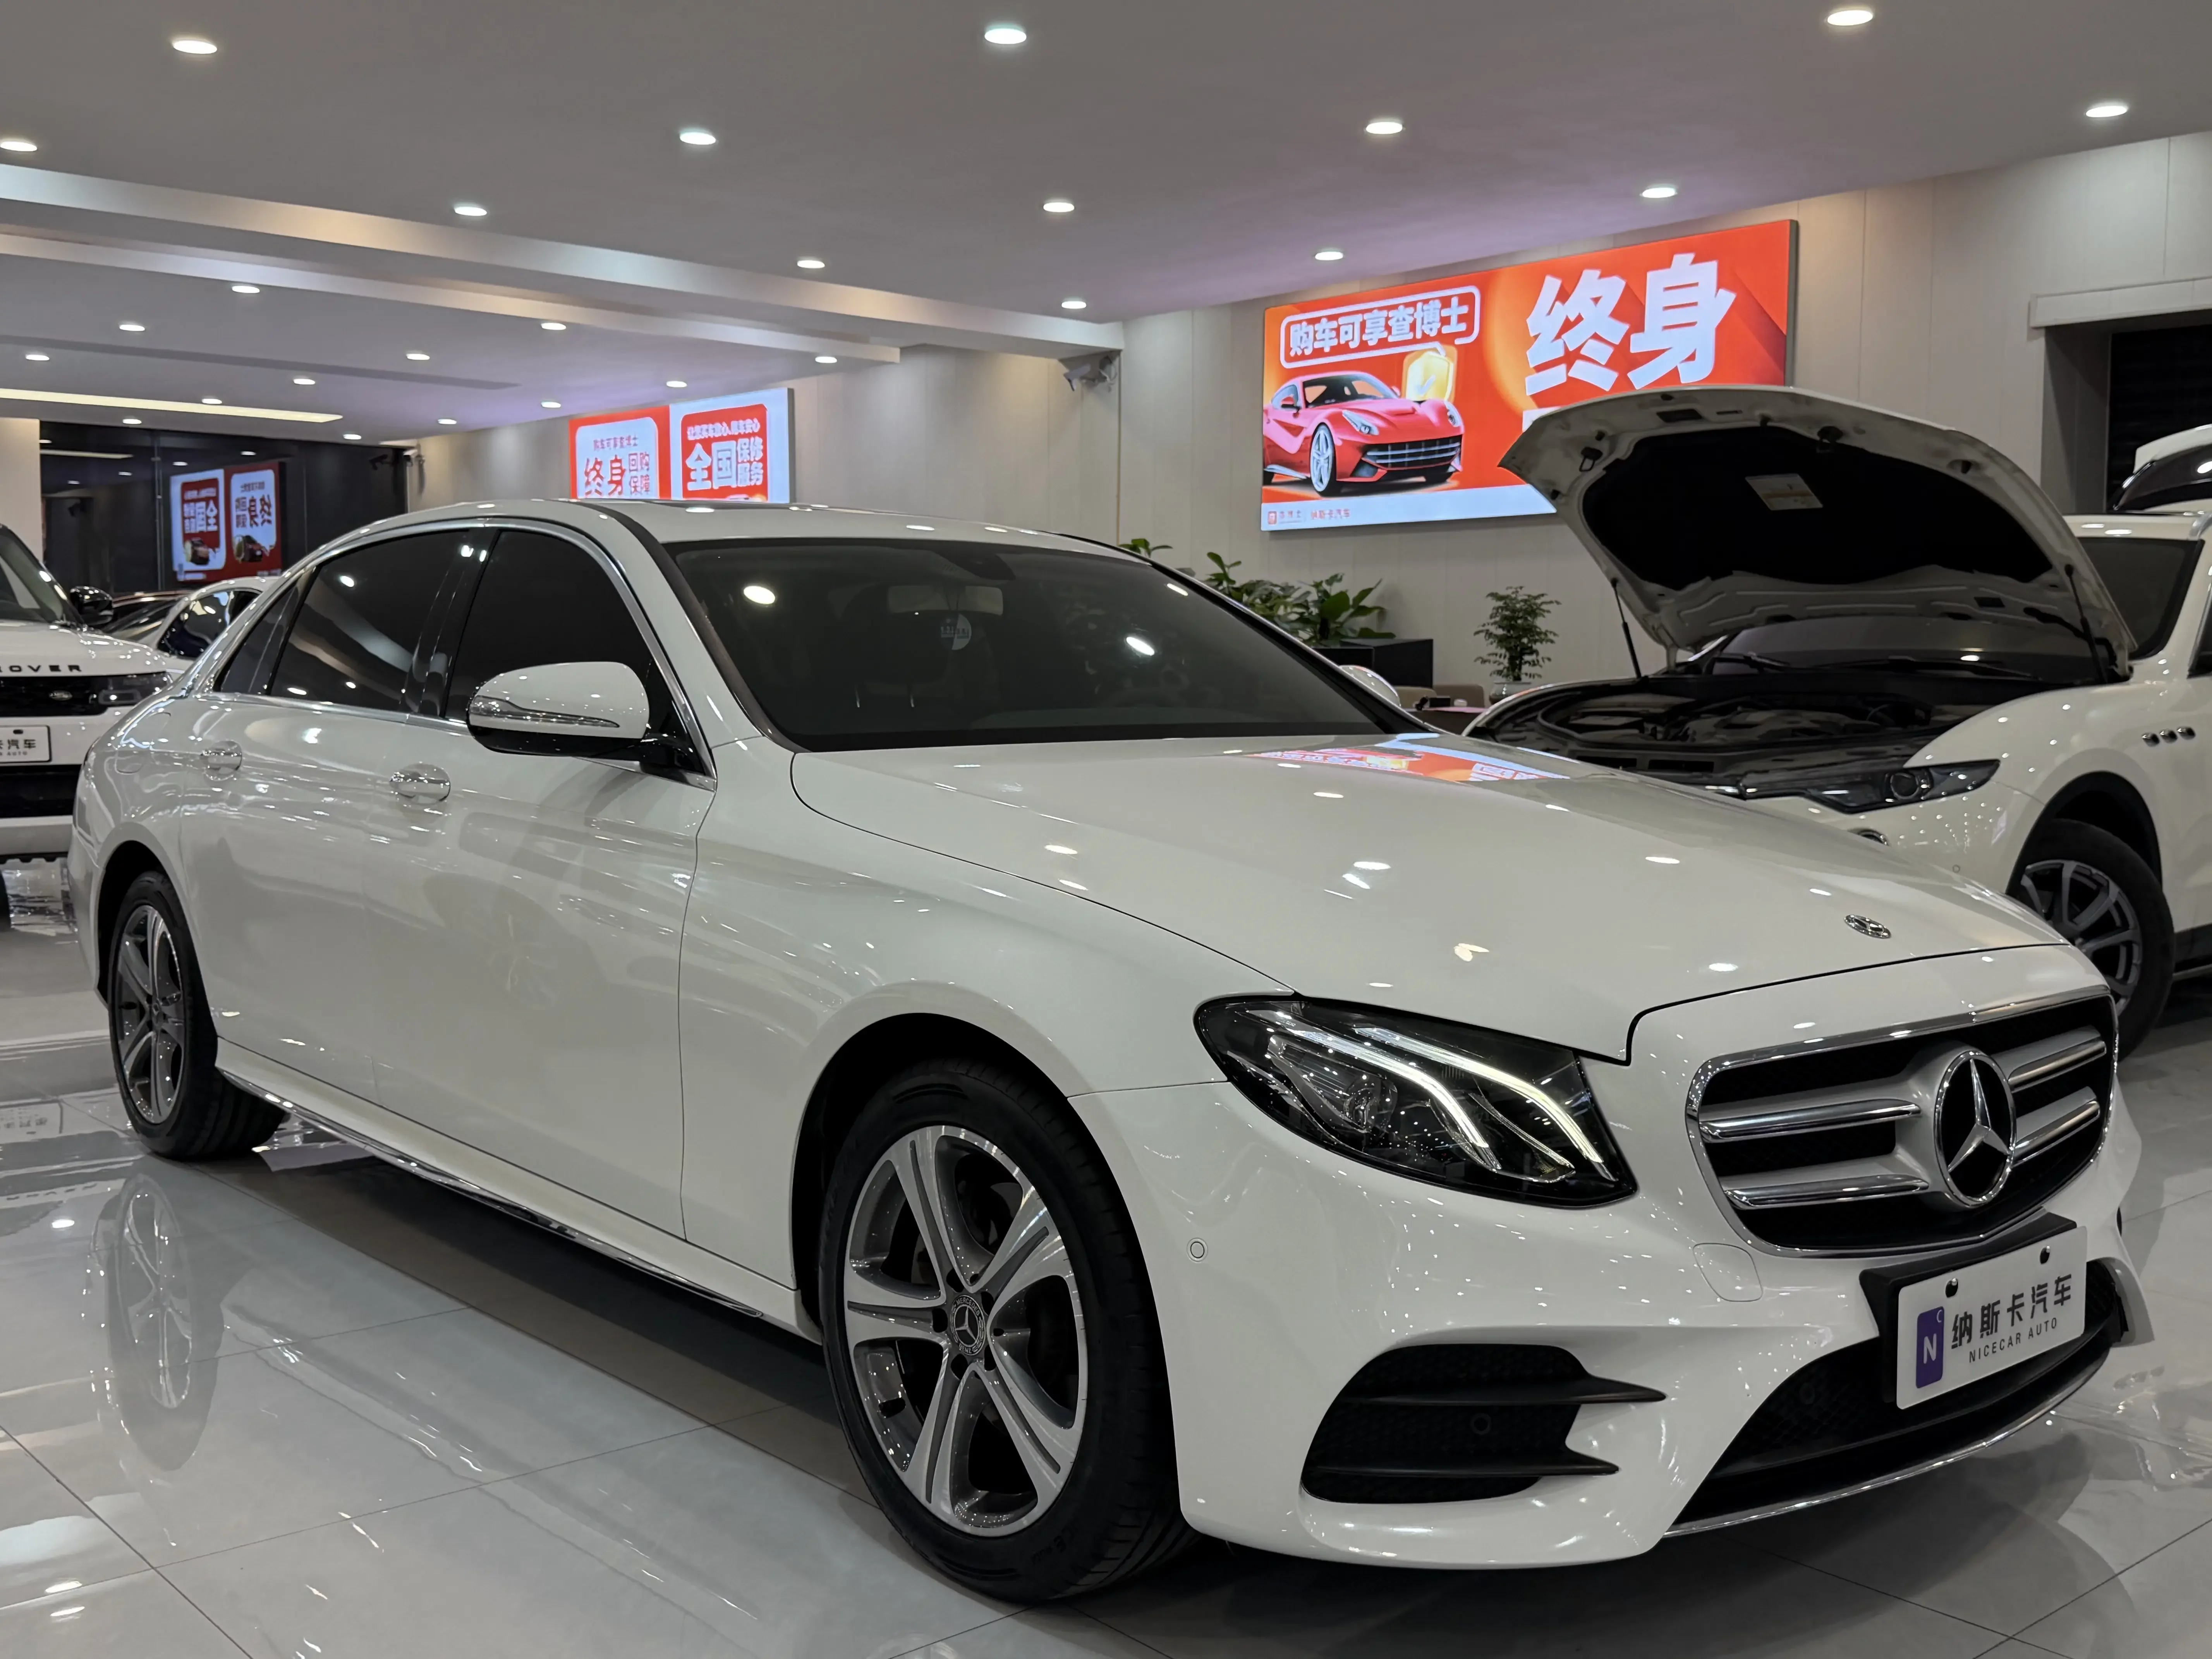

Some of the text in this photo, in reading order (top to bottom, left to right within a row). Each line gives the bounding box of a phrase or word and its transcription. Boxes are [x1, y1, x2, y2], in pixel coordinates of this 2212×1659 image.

[1290, 296, 1469, 357] 购车可享查博士
[1525, 253, 1736, 396] 终身
[584, 454, 626, 496] 终身
[629, 452, 650, 472] 回购
[685, 440, 737, 491] 全国
[0, 665, 82, 673] OVER
[956, 1297, 981, 1316] MERCEDES
[1951, 1274, 2072, 1350] 纳斯卡汽车
[959, 1343, 972, 1354] BENZ
[1969, 1317, 2057, 1363] NICECAR AUTO
